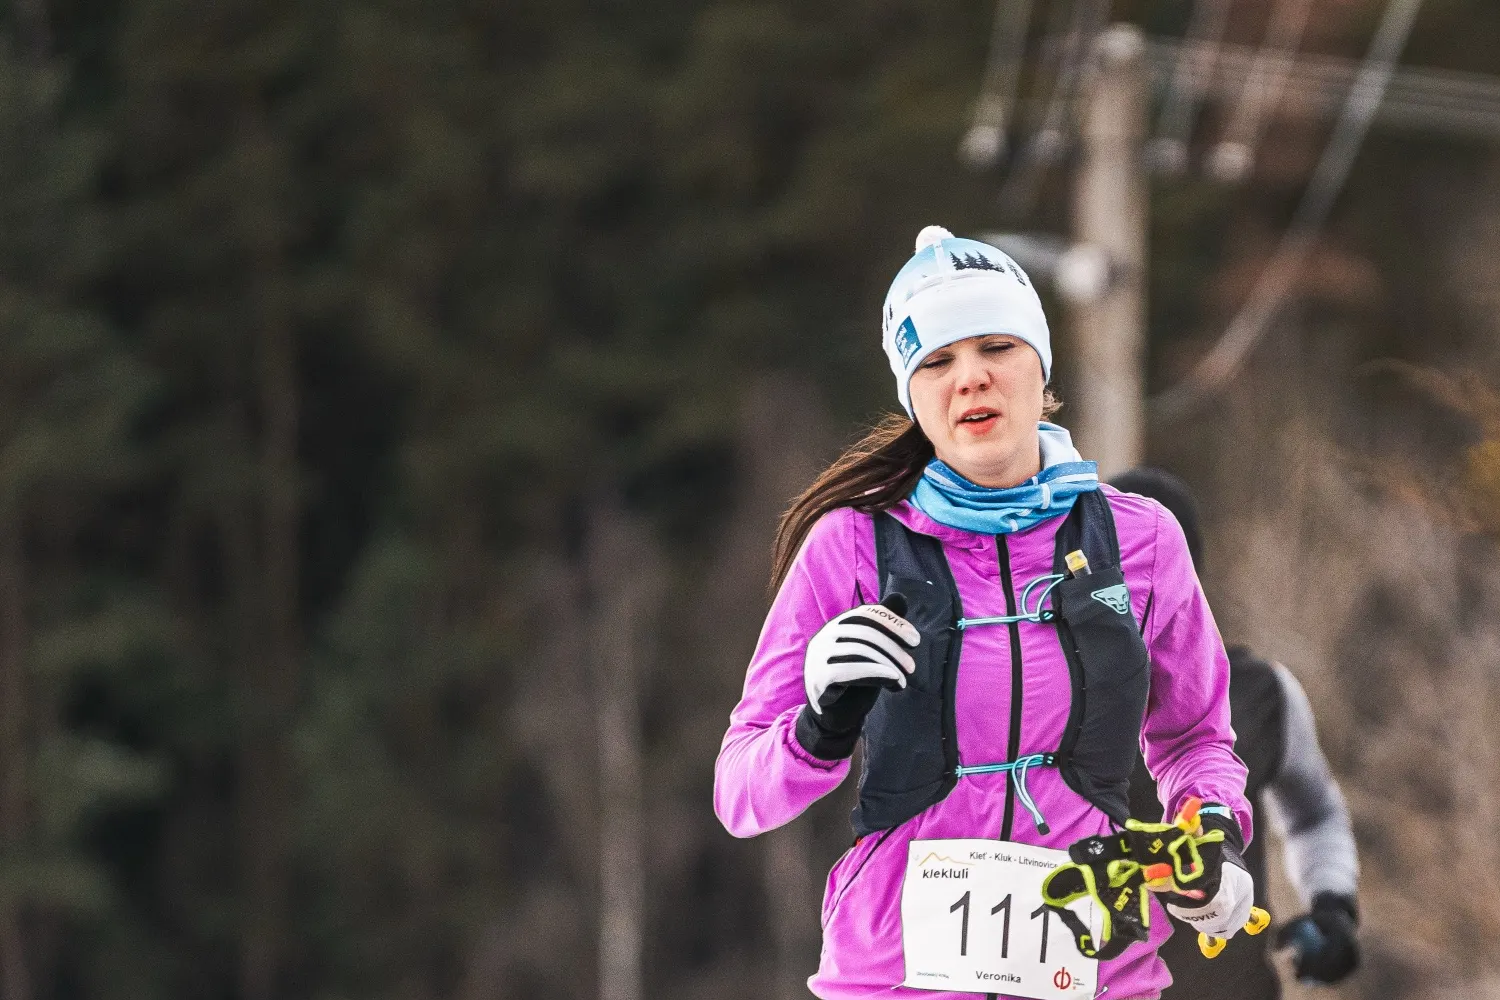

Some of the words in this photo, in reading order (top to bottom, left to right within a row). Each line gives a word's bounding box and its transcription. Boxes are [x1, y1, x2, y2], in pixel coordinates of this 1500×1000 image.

[994, 852, 1012, 863] Kluk
[922, 867, 969, 879] klekluli
[949, 890, 1050, 964] 111
[975, 970, 1022, 984] Veronika
